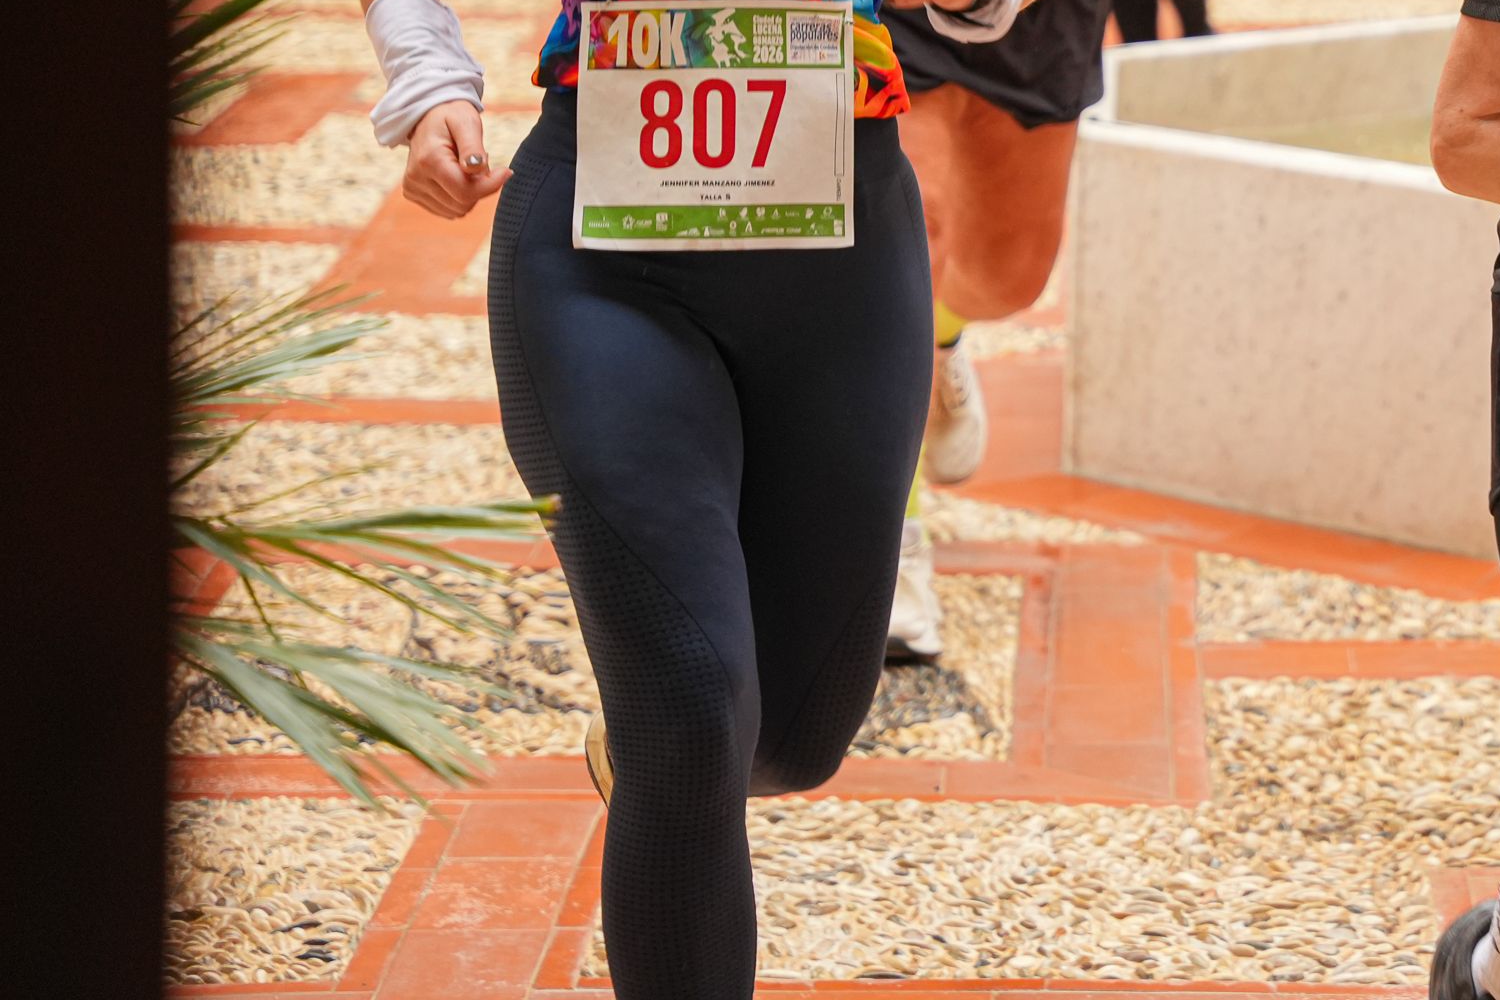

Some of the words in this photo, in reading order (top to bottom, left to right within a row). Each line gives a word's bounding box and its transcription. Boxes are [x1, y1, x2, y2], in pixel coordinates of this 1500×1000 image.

[790, 22, 832, 32] carreras
[607, 11, 688, 67] 10K
[790, 30, 838, 43] populares
[753, 46, 783, 63] 2026
[639, 78, 787, 168] 807
